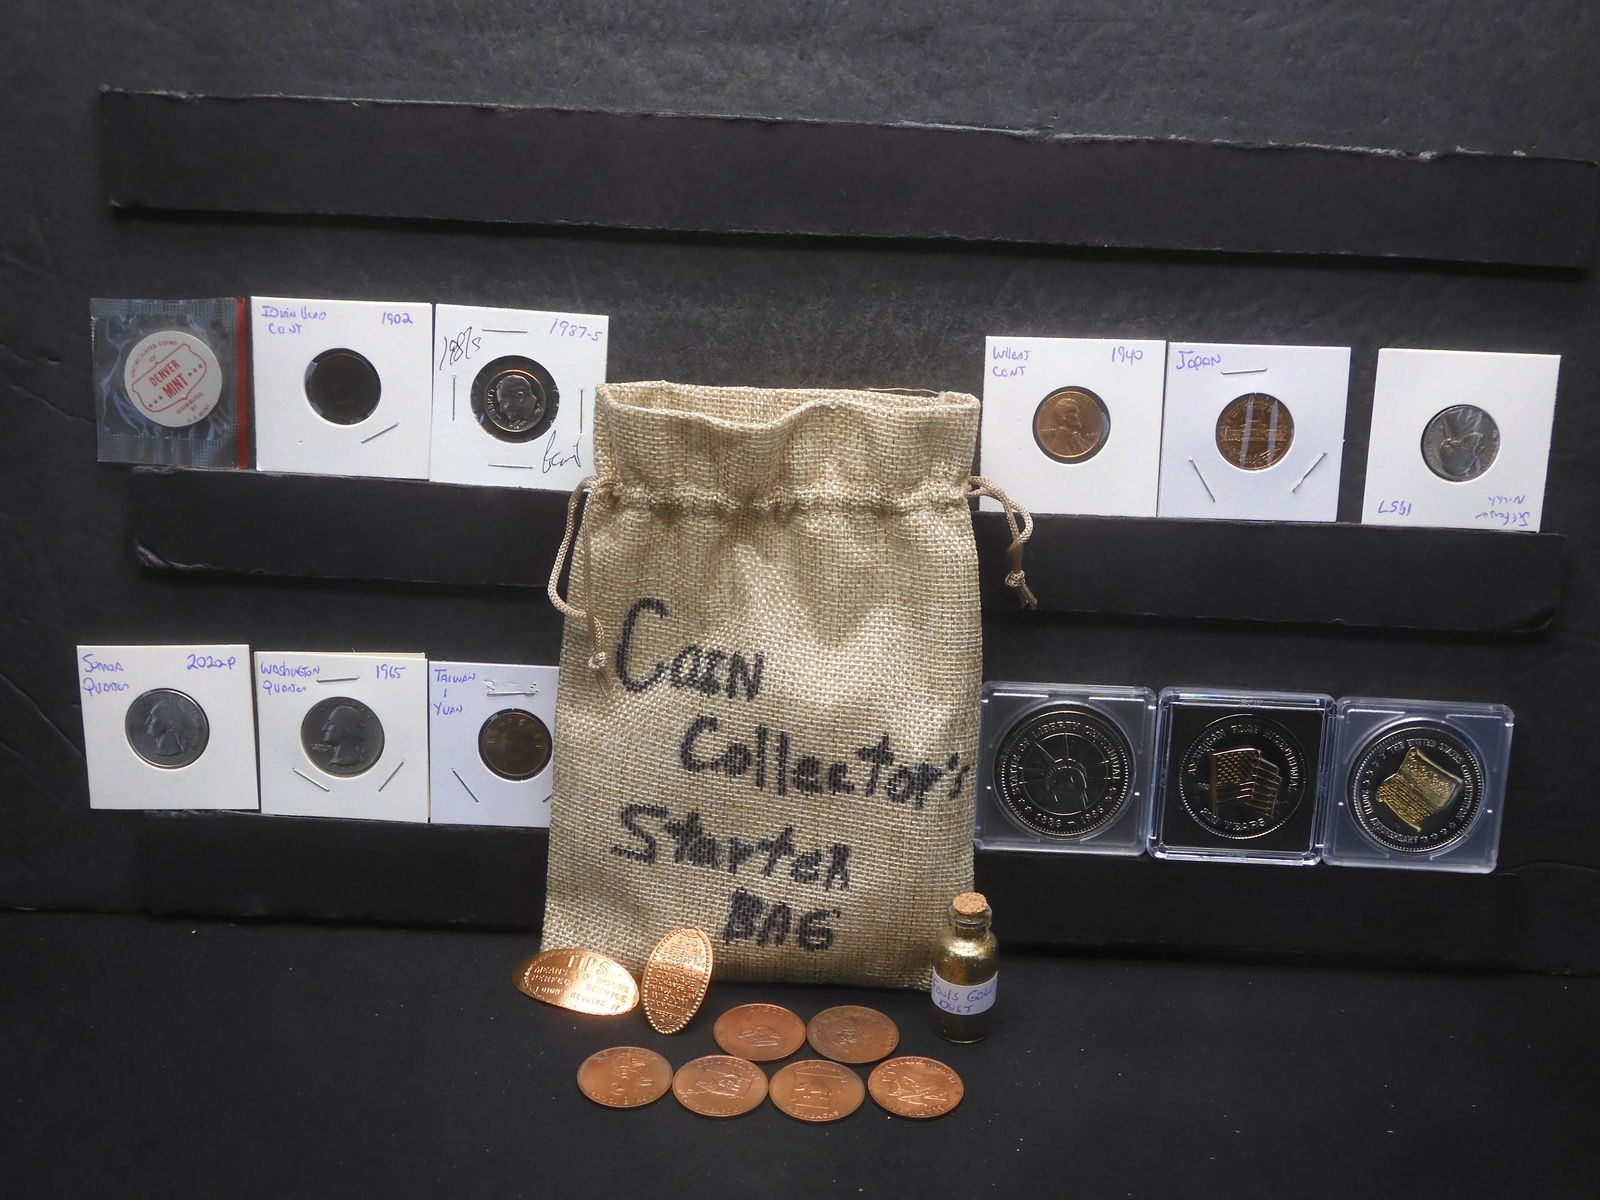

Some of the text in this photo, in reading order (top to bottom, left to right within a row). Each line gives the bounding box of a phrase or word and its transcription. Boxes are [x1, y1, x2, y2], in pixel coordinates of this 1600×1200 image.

[381, 311, 413, 325] 1902
[1111, 346, 1144, 365] 1940
[149, 359, 181, 387] DENVER
[162, 373, 189, 399] MINT
[1378, 499, 1413, 516] 1957
[376, 663, 407, 680] 1965
[433, 701, 463, 716] YUAN
[723, 886, 842, 951] BAG
